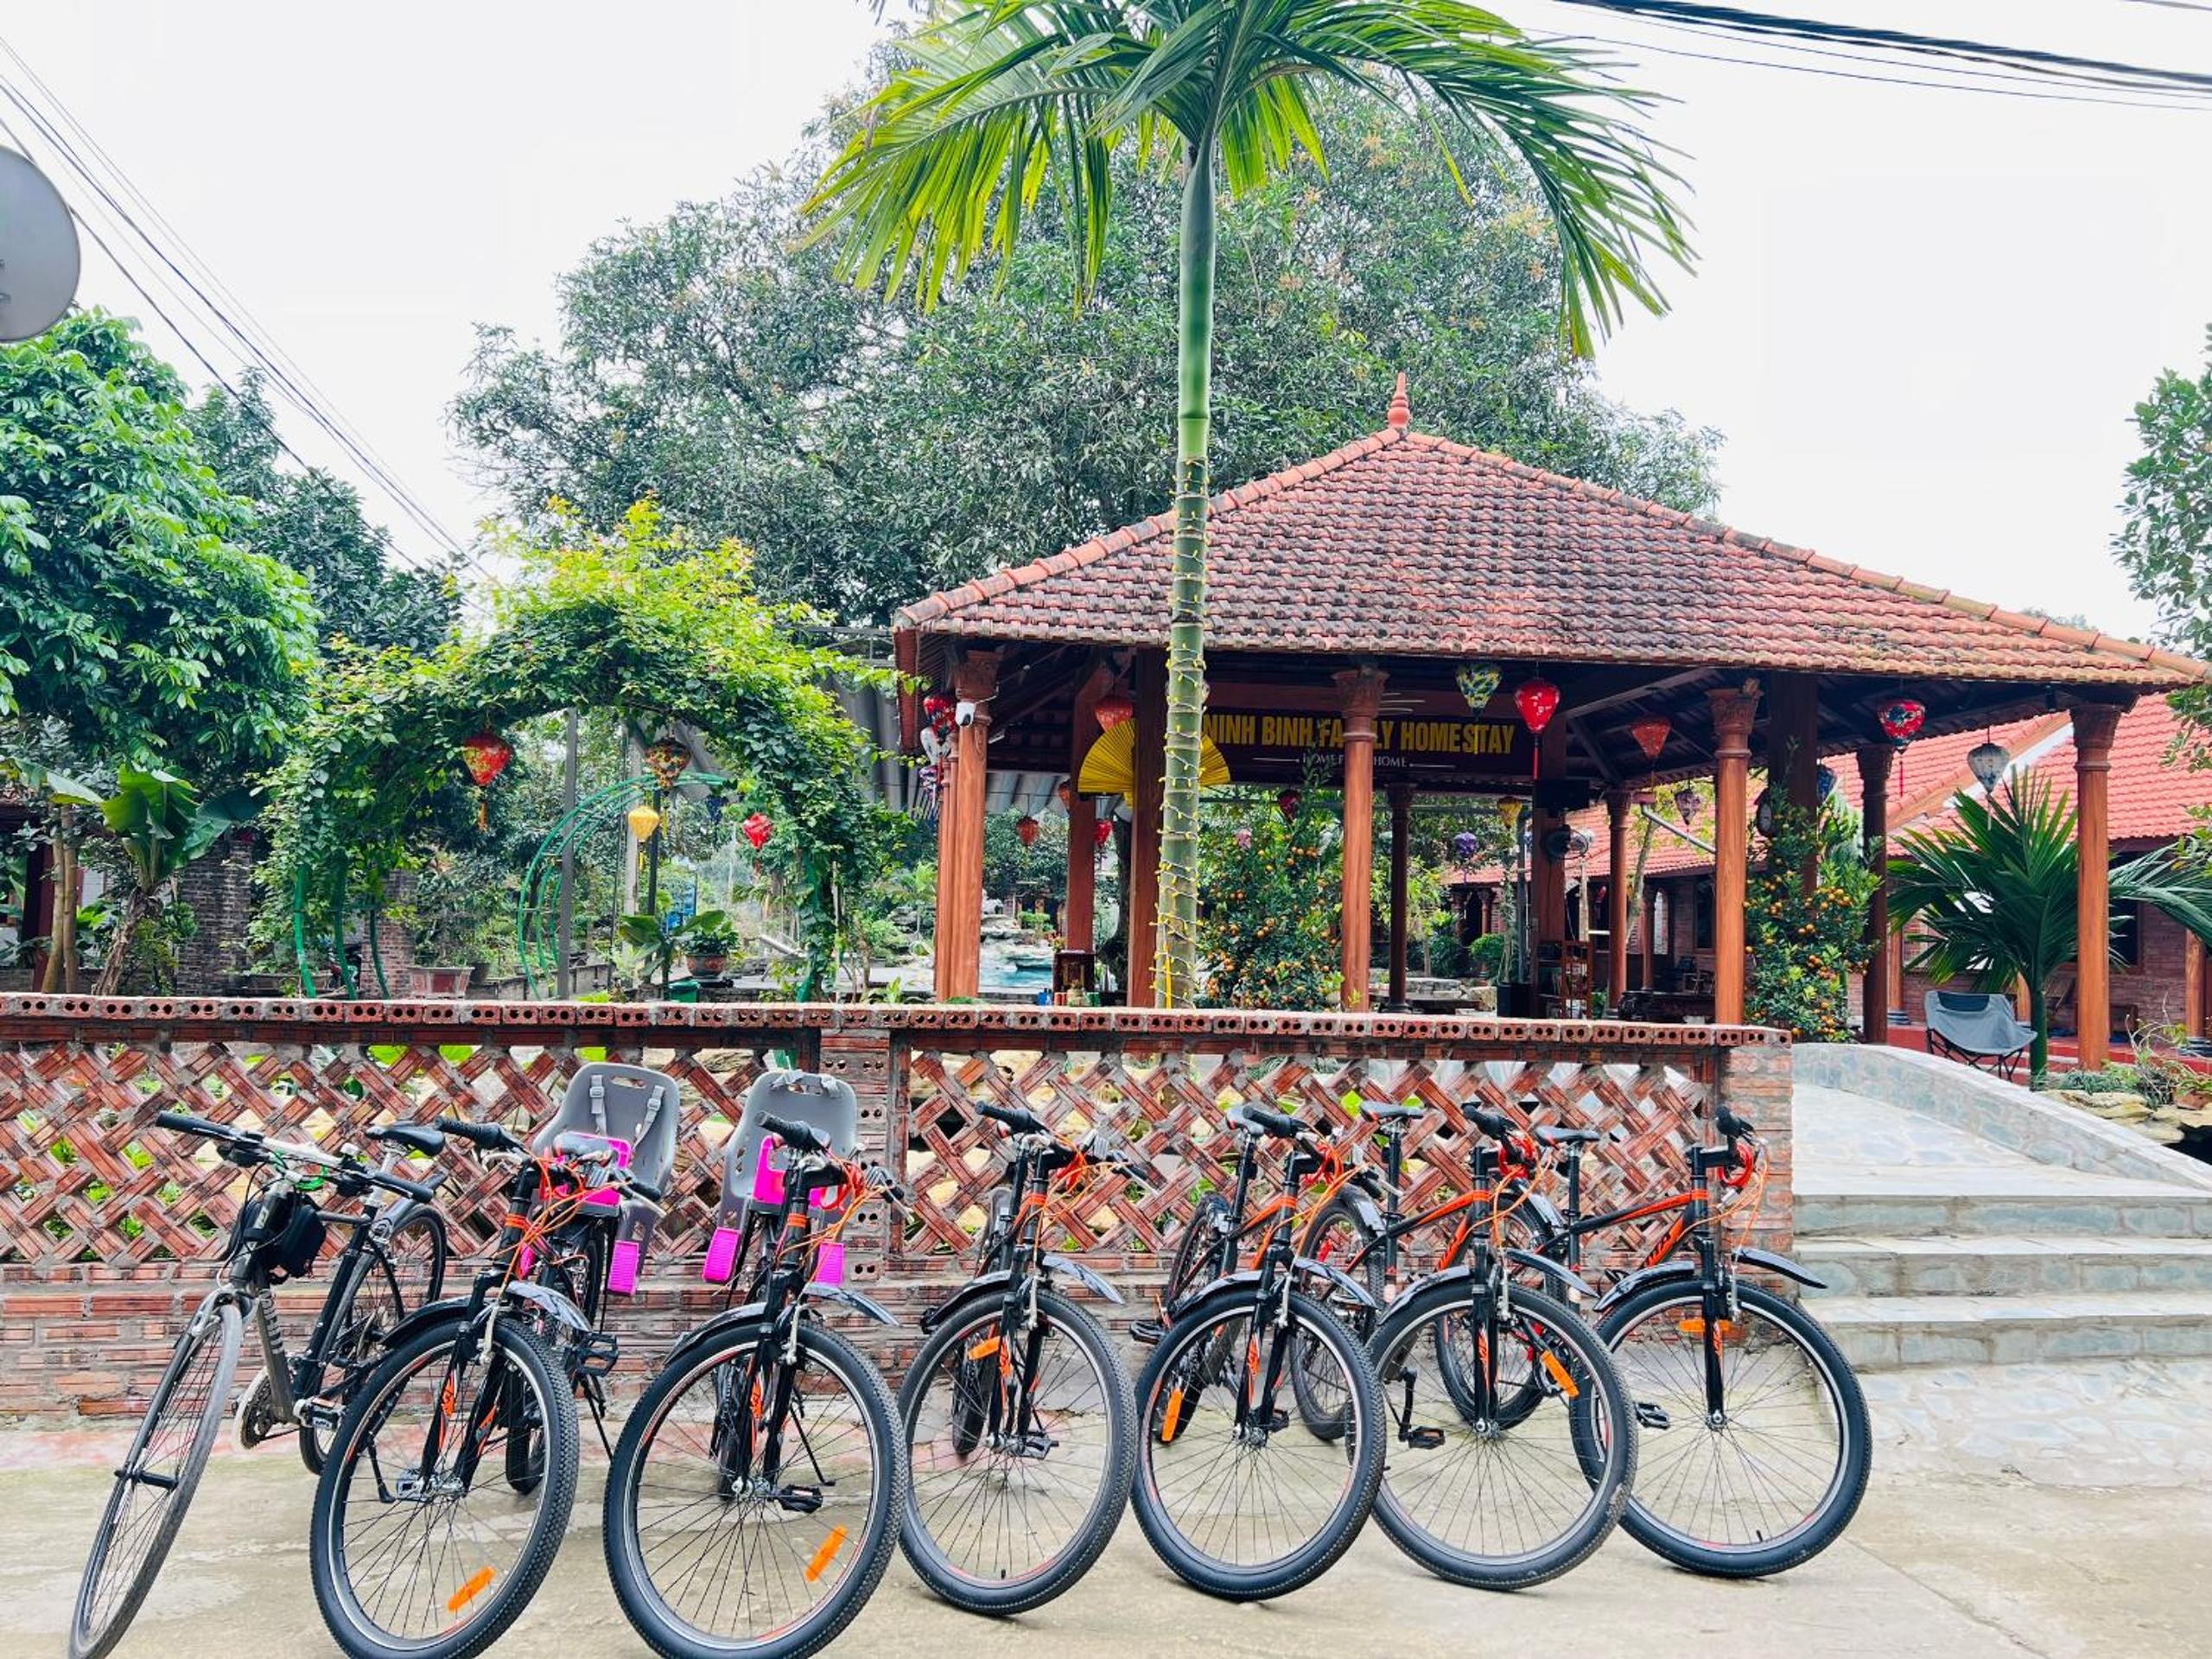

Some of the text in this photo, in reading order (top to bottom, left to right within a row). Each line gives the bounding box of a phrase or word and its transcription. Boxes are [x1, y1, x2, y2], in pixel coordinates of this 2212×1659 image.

[1262, 716, 1313, 747] BINH
[1319, 719, 1394, 749] FALY
[1401, 721, 1515, 754] HOMESTAY
